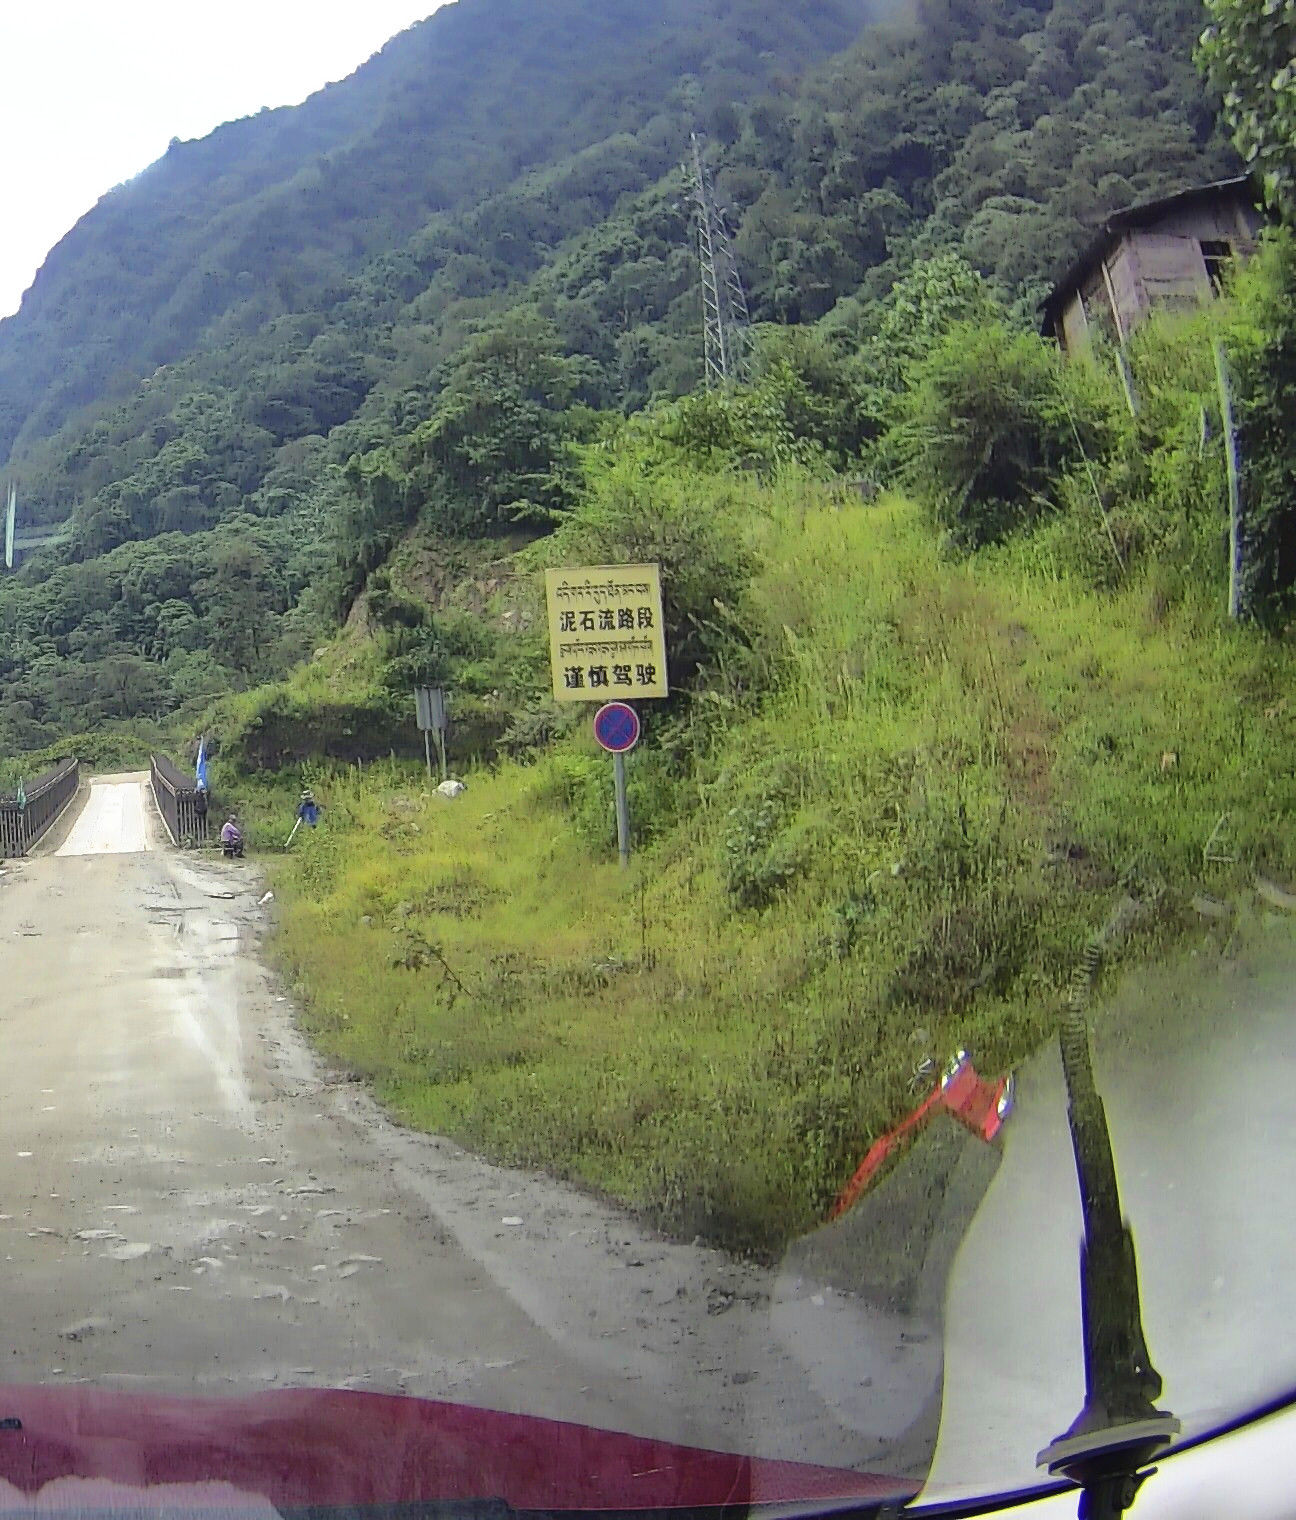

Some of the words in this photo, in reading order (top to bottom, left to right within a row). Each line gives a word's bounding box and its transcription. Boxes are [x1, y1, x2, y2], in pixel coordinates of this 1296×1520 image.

[560, 607, 654, 632] 泥石流路段
[564, 664, 656, 688] 谨慎驾驶
